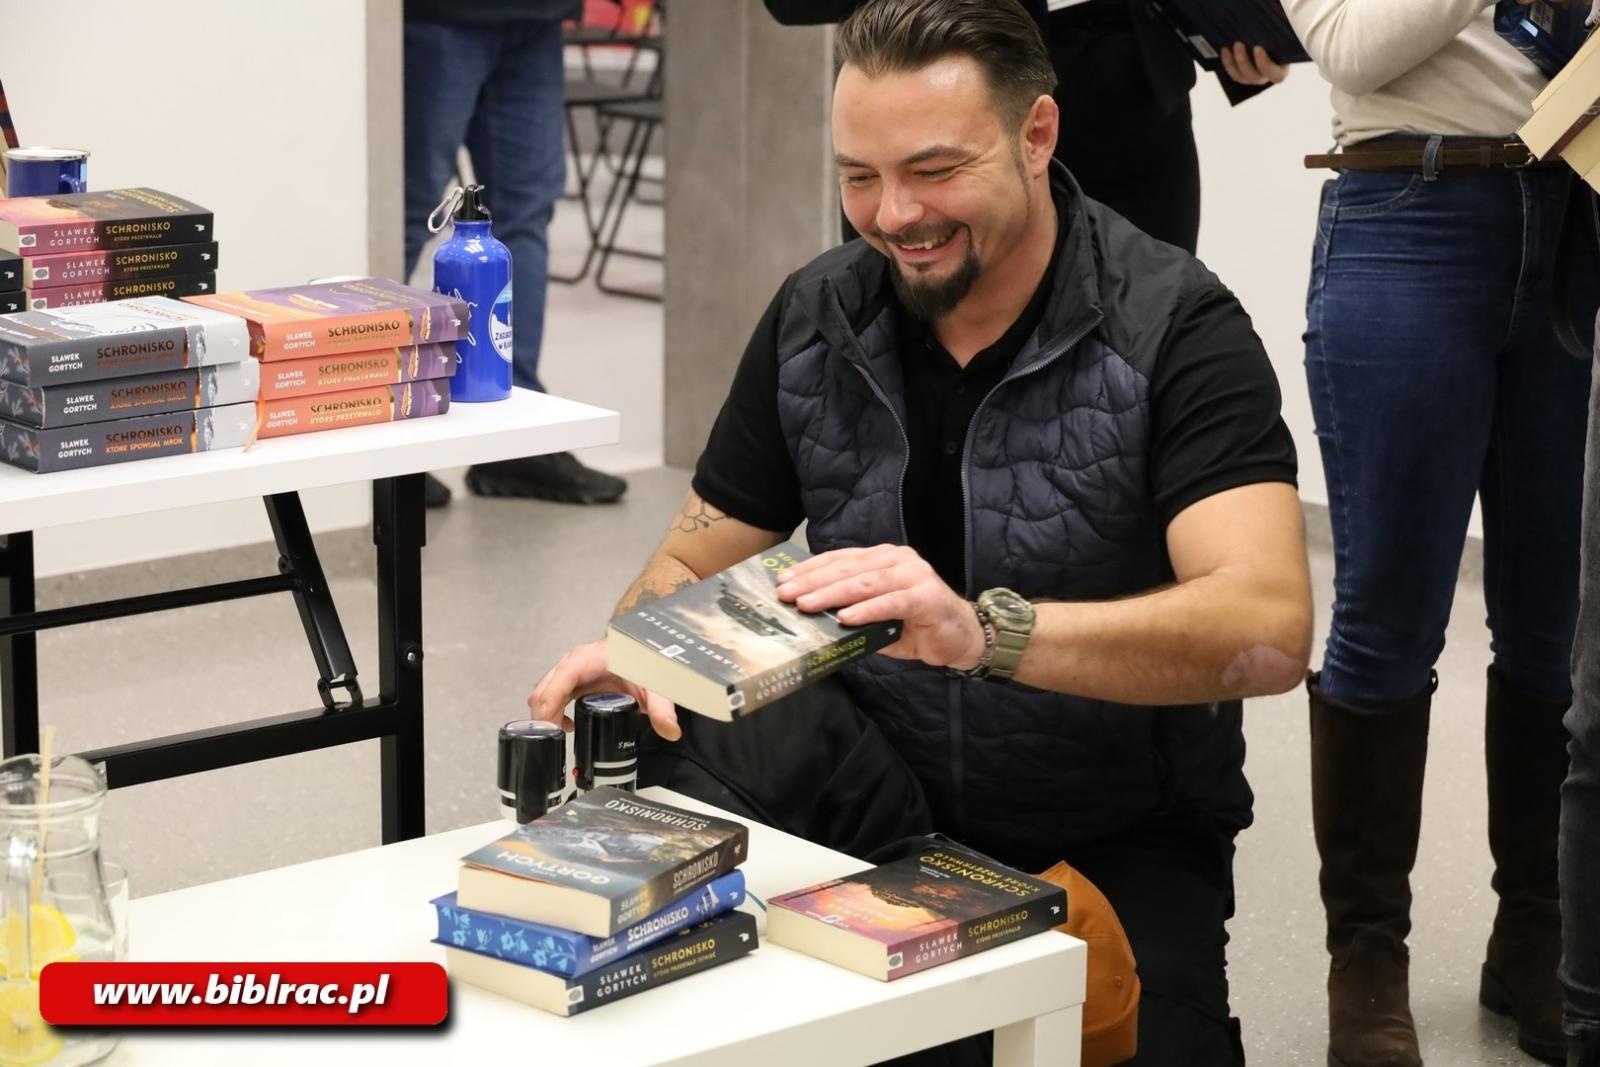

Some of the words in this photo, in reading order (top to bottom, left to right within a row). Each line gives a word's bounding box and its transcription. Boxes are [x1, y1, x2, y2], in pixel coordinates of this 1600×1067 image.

[106, 221, 171, 234] SCHRONISKO
[49, 236, 100, 247] GORTYCH
[115, 251, 178, 266] SCHRONISKO
[62, 268, 110, 279] GORTYCH
[113, 281, 175, 296] SCHRONISKO
[328, 320, 400, 337] SCHRONISKO
[97, 340, 175, 359] SCHRONISKO
[284, 340, 316, 350] GORTYCH
[48, 362, 83, 373] GORTYCH
[318, 359, 389, 376] SCHRONISKO
[111, 381, 187, 398] SCHRONISKO
[275, 379, 306, 389] GORTYCH
[63, 404, 98, 414] GORTYCH
[311, 397, 382, 413] SCHRONISKO
[267, 418, 298, 428] GORTYCH
[105, 425, 183, 442] SCHRONISKO
[58, 448, 92, 458] GORTYCH
[638, 611, 695, 645] GORTYCH
[604, 799, 707, 831] SCHRONISKO
[496, 851, 610, 885] GORTYCH
[673, 851, 719, 889] SCHRONISKO
[920, 856, 1030, 897] SCHRONISKO
[1003, 877, 1040, 892] KTÓRE
[628, 907, 688, 942] SCHRONISKO
[968, 910, 1028, 937] SCHRONISKO
[652, 939, 715, 968] SCHRONISKO
[916, 942, 962, 963] GORTYCH
[597, 974, 647, 997] GORTYCH
